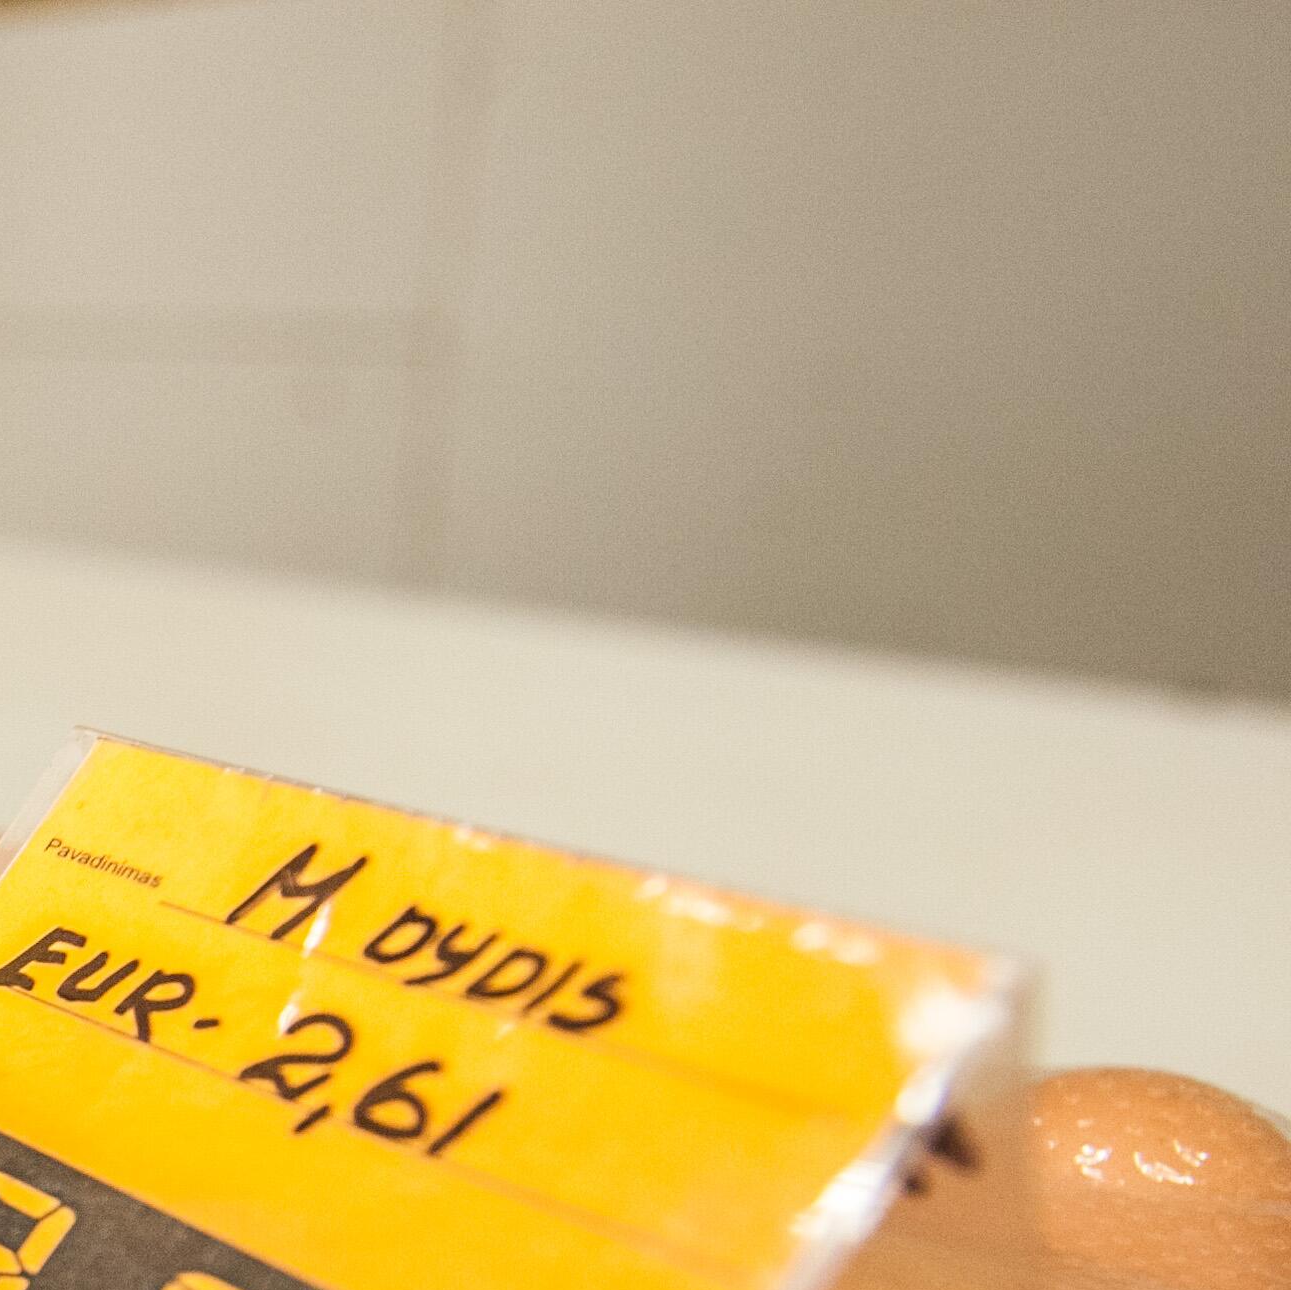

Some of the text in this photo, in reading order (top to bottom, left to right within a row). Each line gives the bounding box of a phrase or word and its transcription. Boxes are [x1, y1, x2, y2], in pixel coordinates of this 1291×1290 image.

[43, 837, 165, 889] Pavadinimas
[224, 842, 629, 1035] M DYDIS
[238, 1012, 505, 1158] 2,61
